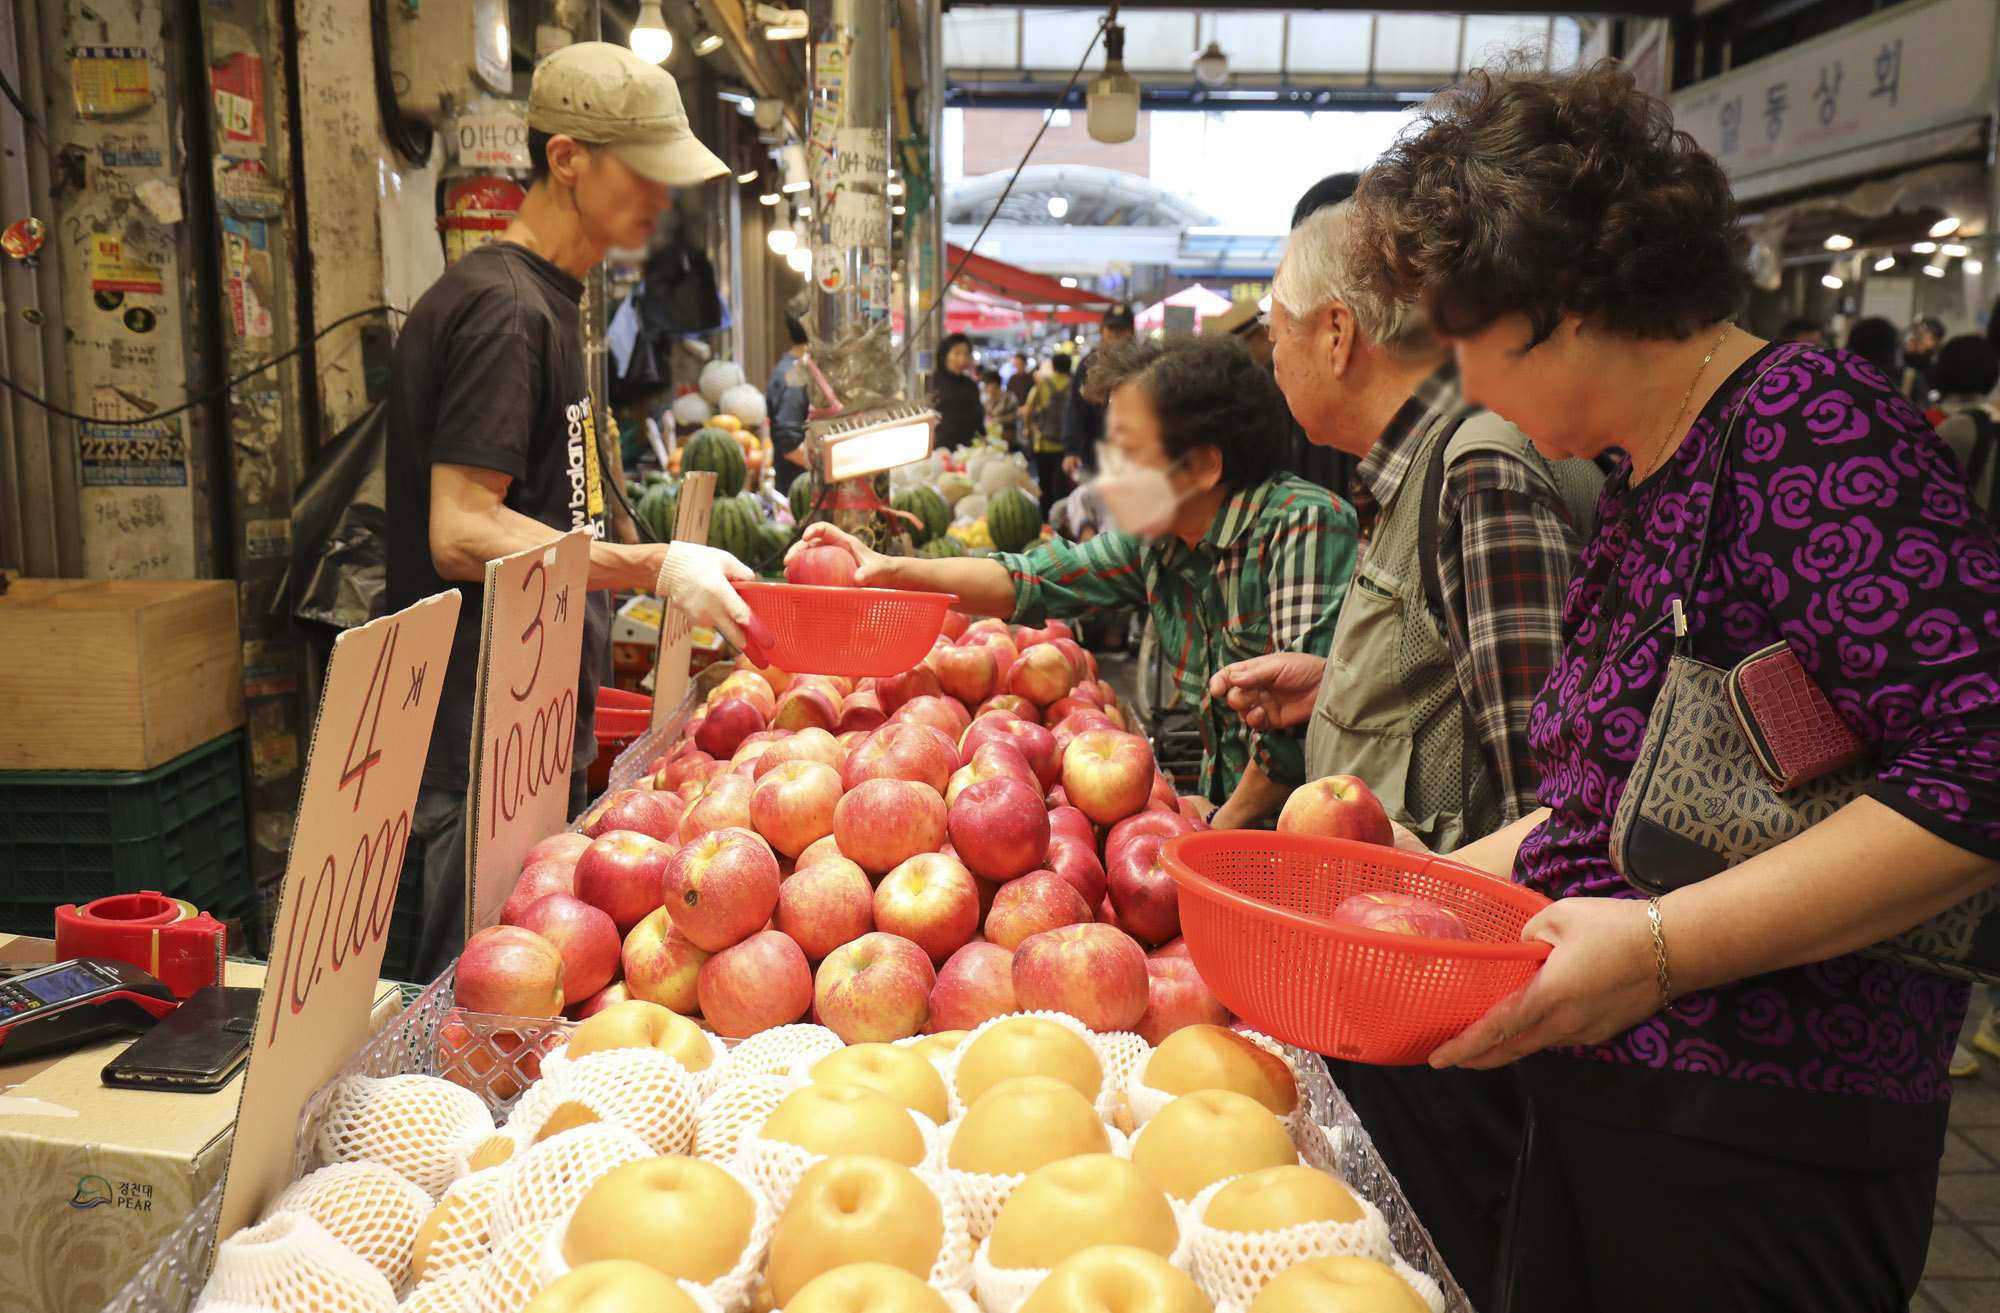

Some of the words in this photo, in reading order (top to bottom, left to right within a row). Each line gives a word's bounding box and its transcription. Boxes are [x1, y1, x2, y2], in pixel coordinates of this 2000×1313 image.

[81, 436, 185, 462] 2232-5252
[566, 403, 586, 509] balance
[510, 559, 547, 702] 3
[338, 622, 400, 813] 4
[117, 1196, 153, 1212] PEAR
[118, 1181, 153, 1199] 경천대
